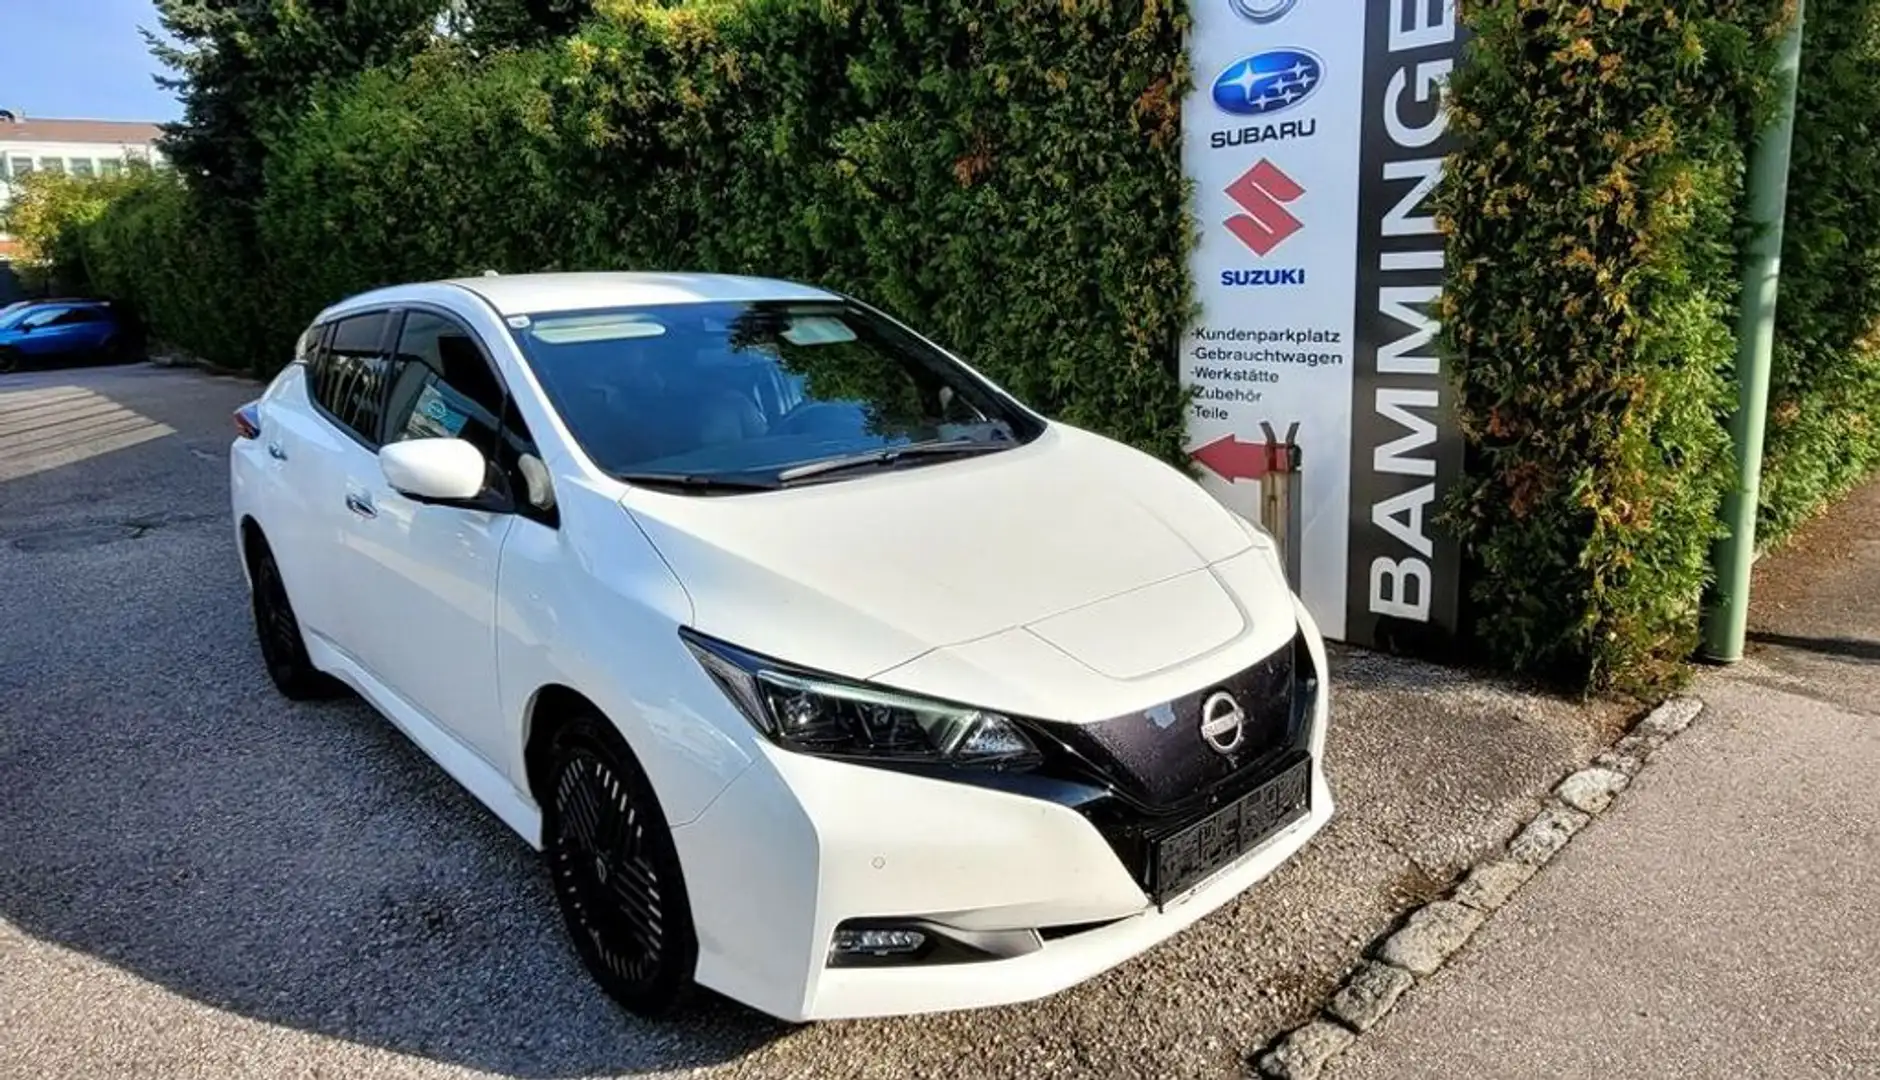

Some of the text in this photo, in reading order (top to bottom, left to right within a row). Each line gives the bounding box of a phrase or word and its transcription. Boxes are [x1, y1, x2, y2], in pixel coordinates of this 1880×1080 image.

[1210, 118, 1316, 148] SUBARU
[1221, 269, 1305, 286] SUZUKI
[1190, 384, 1262, 402] Zubehör
